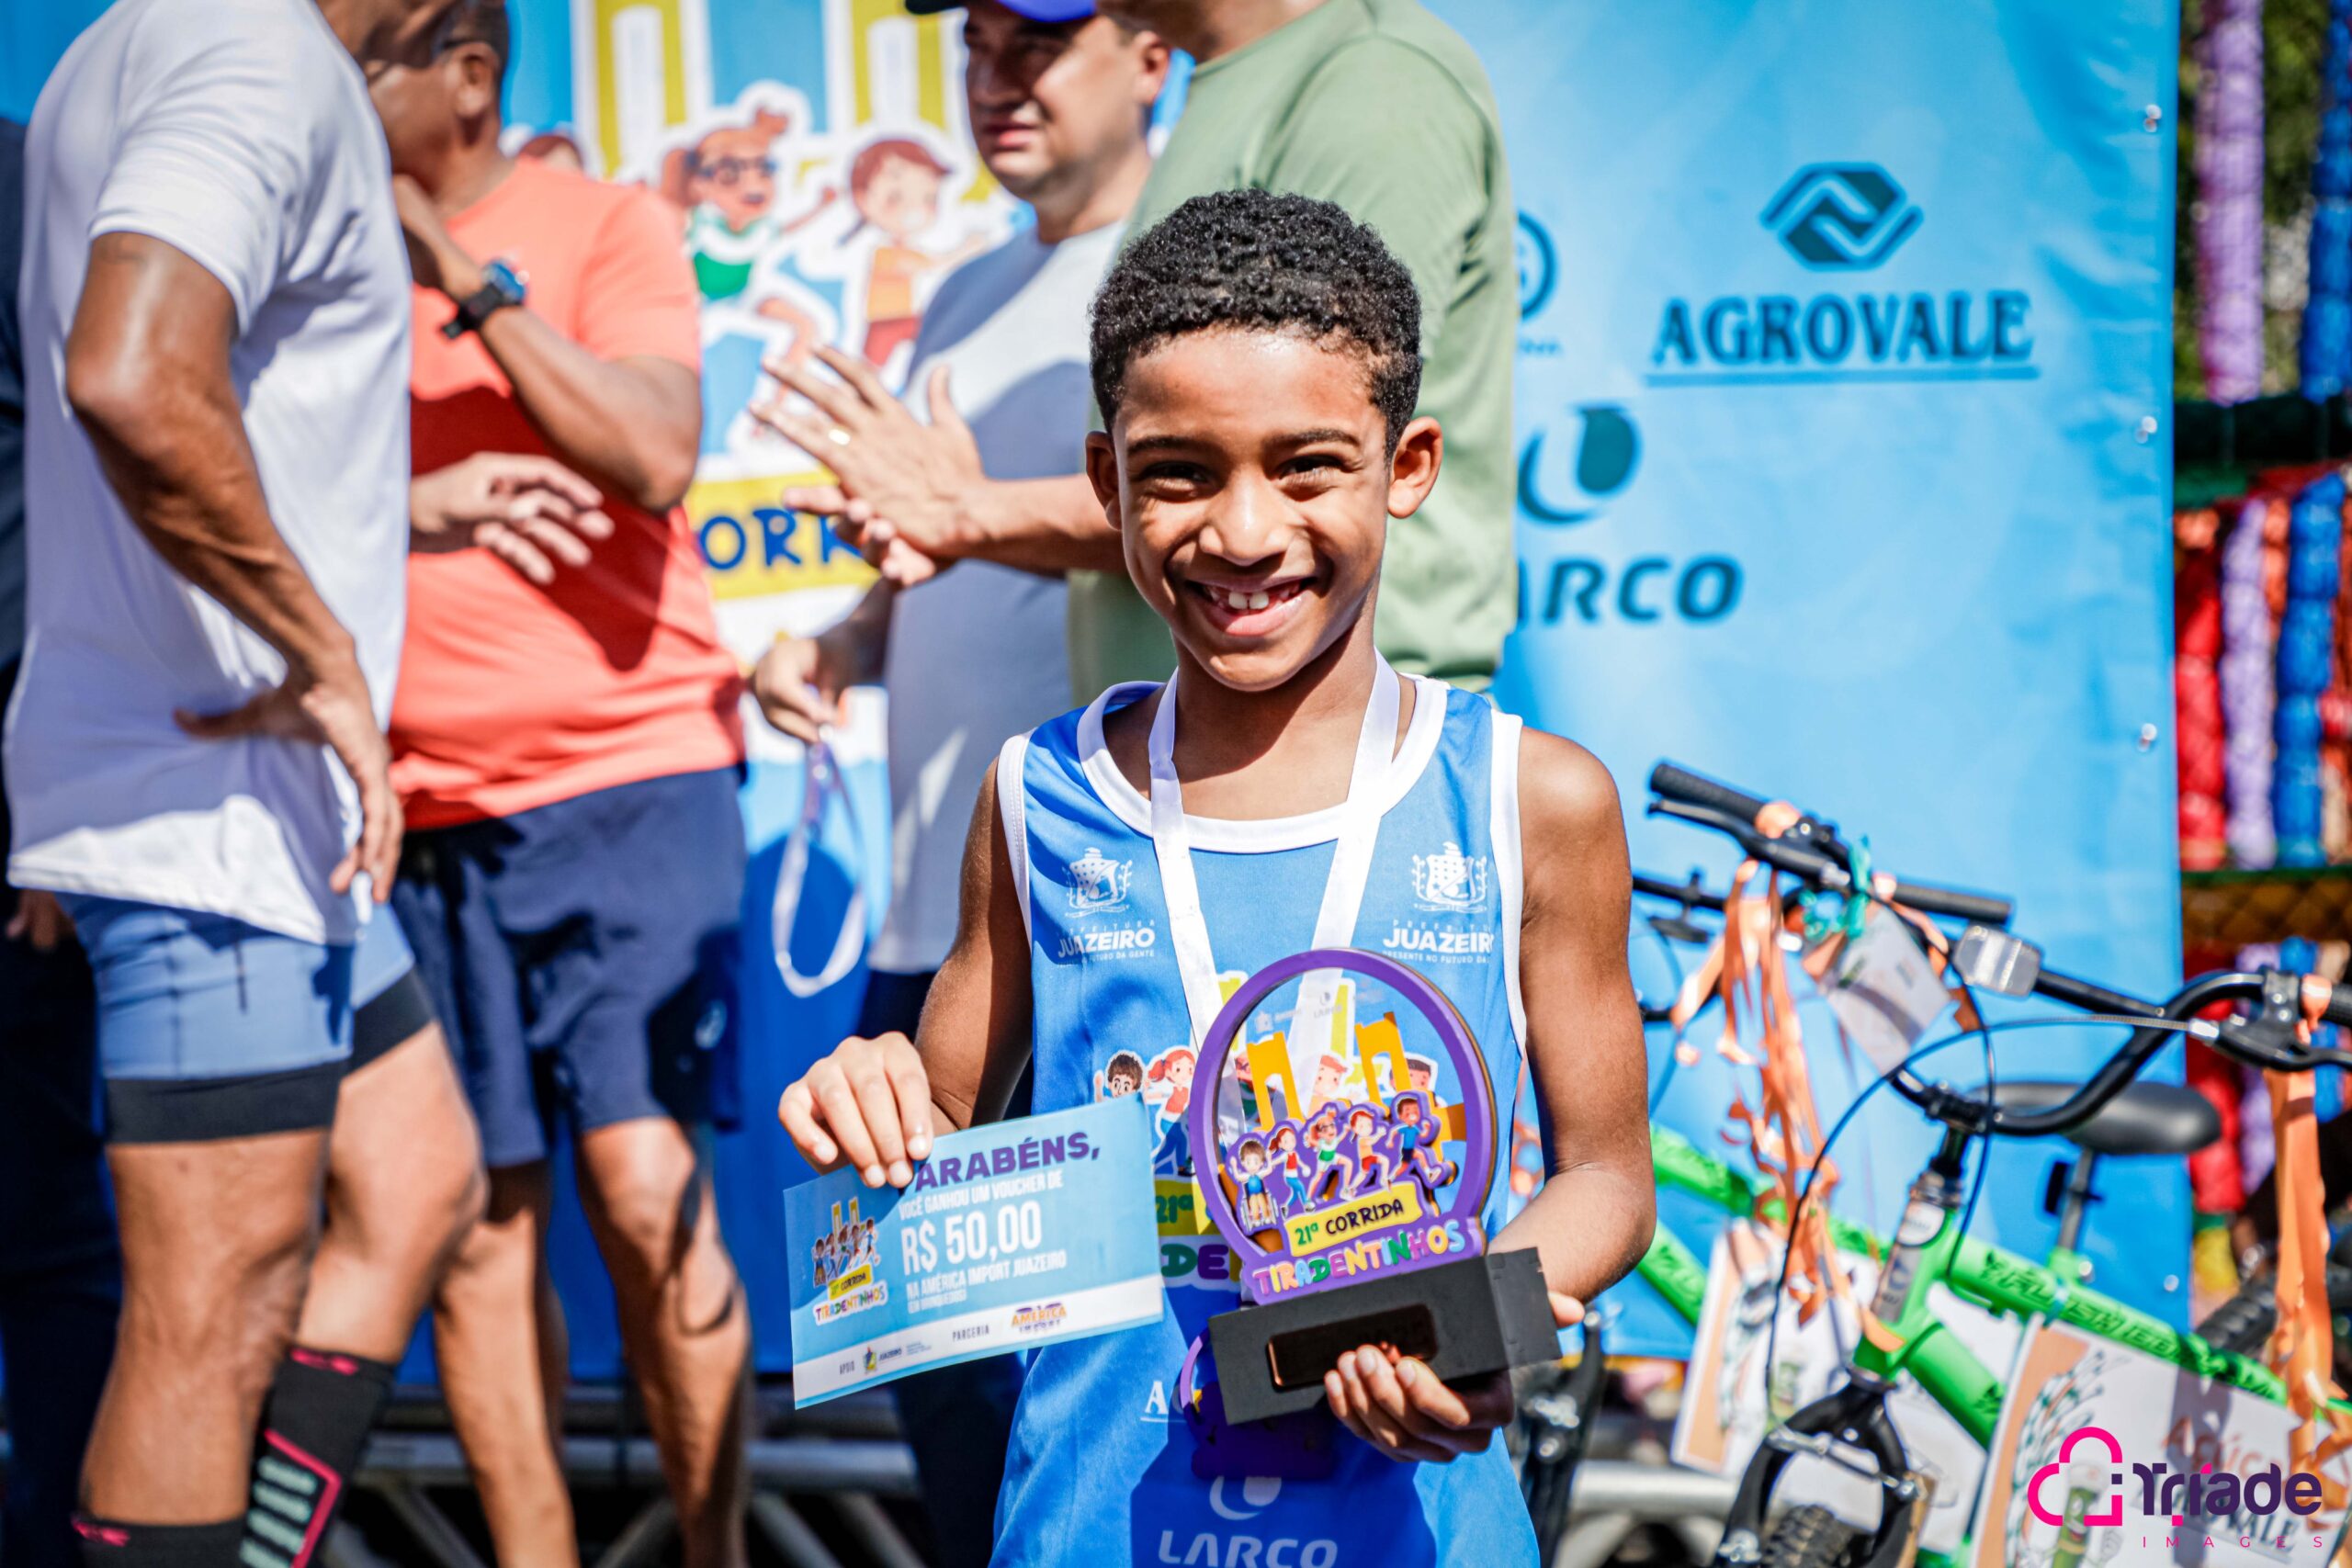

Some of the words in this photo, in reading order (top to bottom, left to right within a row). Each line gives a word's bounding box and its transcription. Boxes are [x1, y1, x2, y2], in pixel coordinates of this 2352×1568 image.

[1652, 291, 2034, 365] AGROVALE
[1517, 556, 1743, 625] RCO
[1057, 928, 1156, 958] JUAZEIRO
[1383, 928, 1494, 954] JUAZEIR
[915, 1132, 1101, 1191] ARABÉNS,
[899, 1195, 923, 1220] VOCÊ
[924, 1189, 969, 1214] GANHOU
[971, 1183, 990, 1204] UM
[991, 1175, 1046, 1200] VOUCHER
[1046, 1168, 1064, 1190] DE
[1325, 1198, 1404, 1236] CORRIDA
[901, 1220, 938, 1276] R$
[945, 1200, 1042, 1264] 50,00
[1252, 1219, 1465, 1296] TIRADENTINHOS
[967, 1260, 1011, 1286] IMPORT
[1012, 1249, 1067, 1278] JUAZEIRO
[815, 1285, 886, 1322] TIRADENTINHOS
[952, 1324, 989, 1341] PARCERIA
[1158, 1529, 1339, 1568] LARCO
